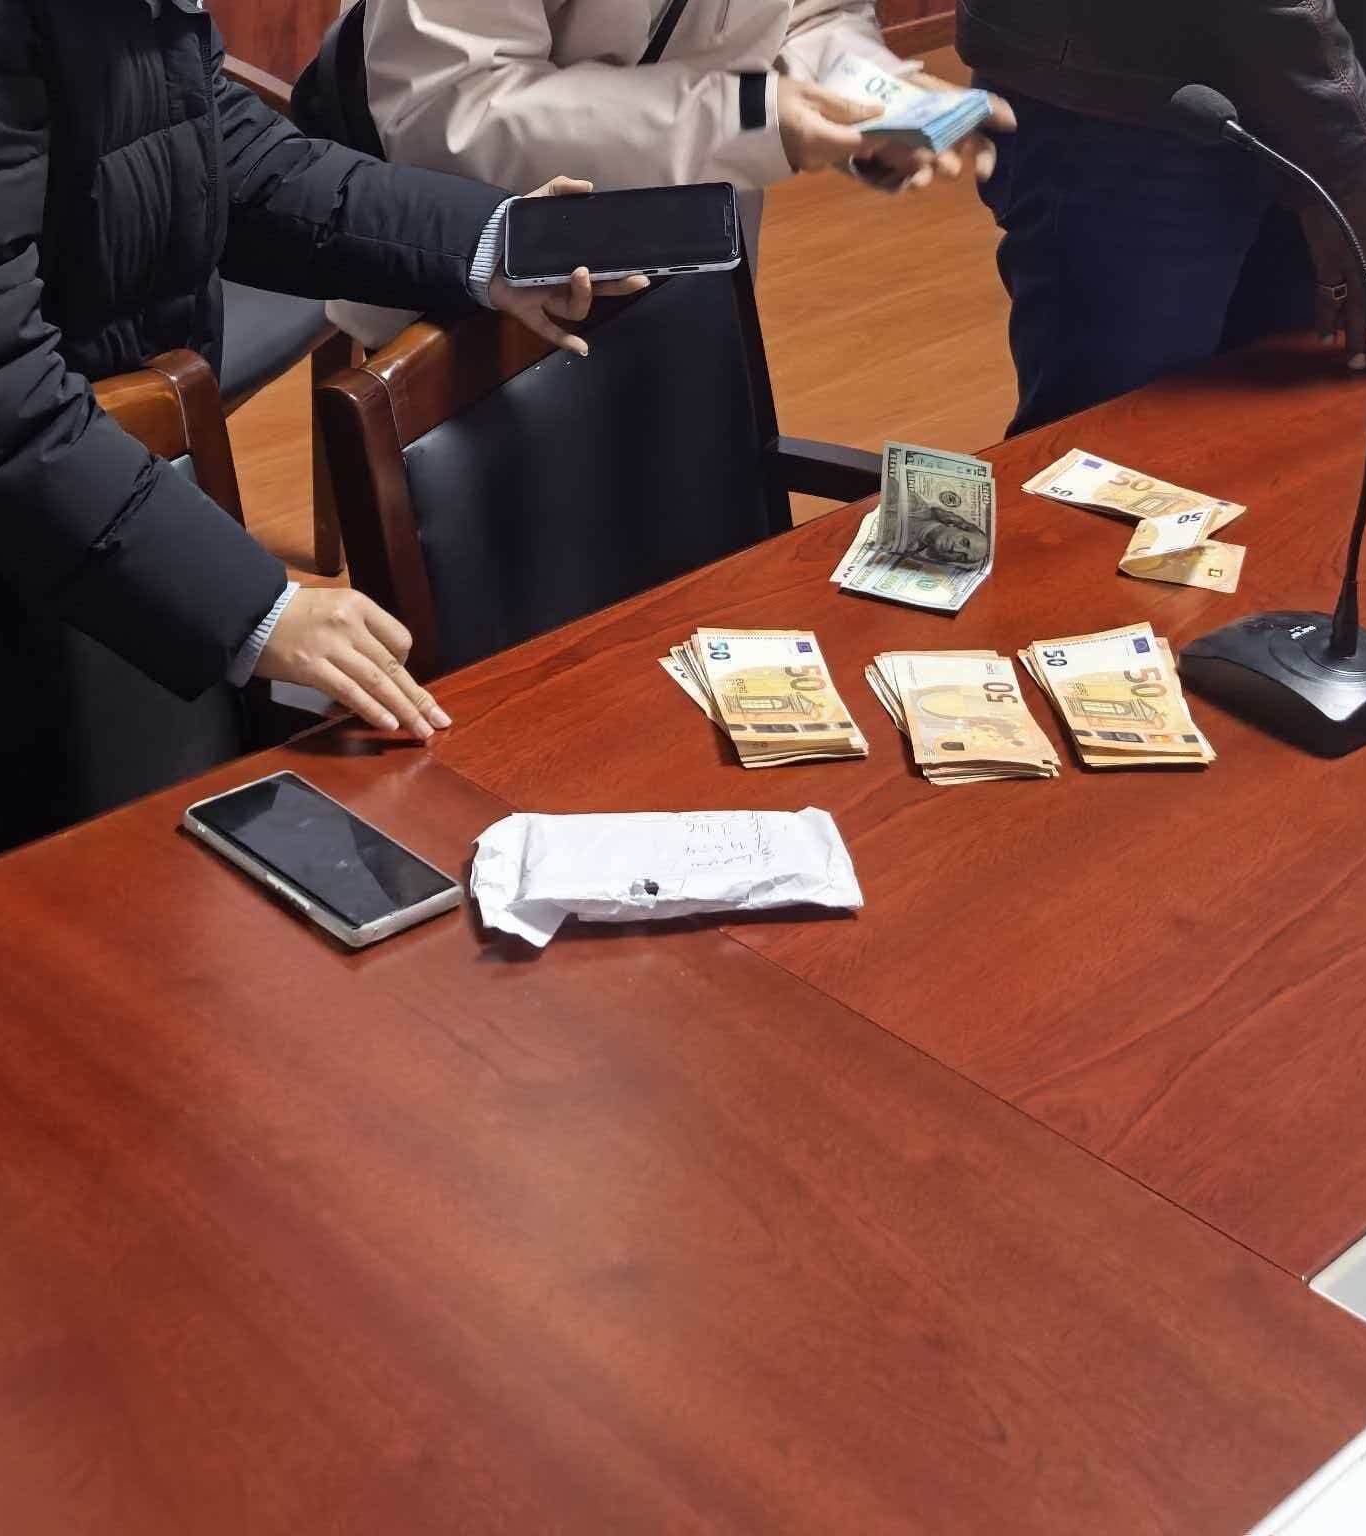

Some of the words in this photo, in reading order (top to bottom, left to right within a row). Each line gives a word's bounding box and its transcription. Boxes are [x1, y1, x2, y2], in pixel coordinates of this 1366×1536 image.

[1048, 486, 1075, 498] 50
[1109, 470, 1155, 492] 50
[1176, 511, 1204, 524] 50
[707, 639, 731, 661] 50
[1042, 649, 1068, 668] 50
[785, 665, 827, 692] 50
[1123, 666, 1167, 698] 50
[982, 681, 1019, 705] 50
